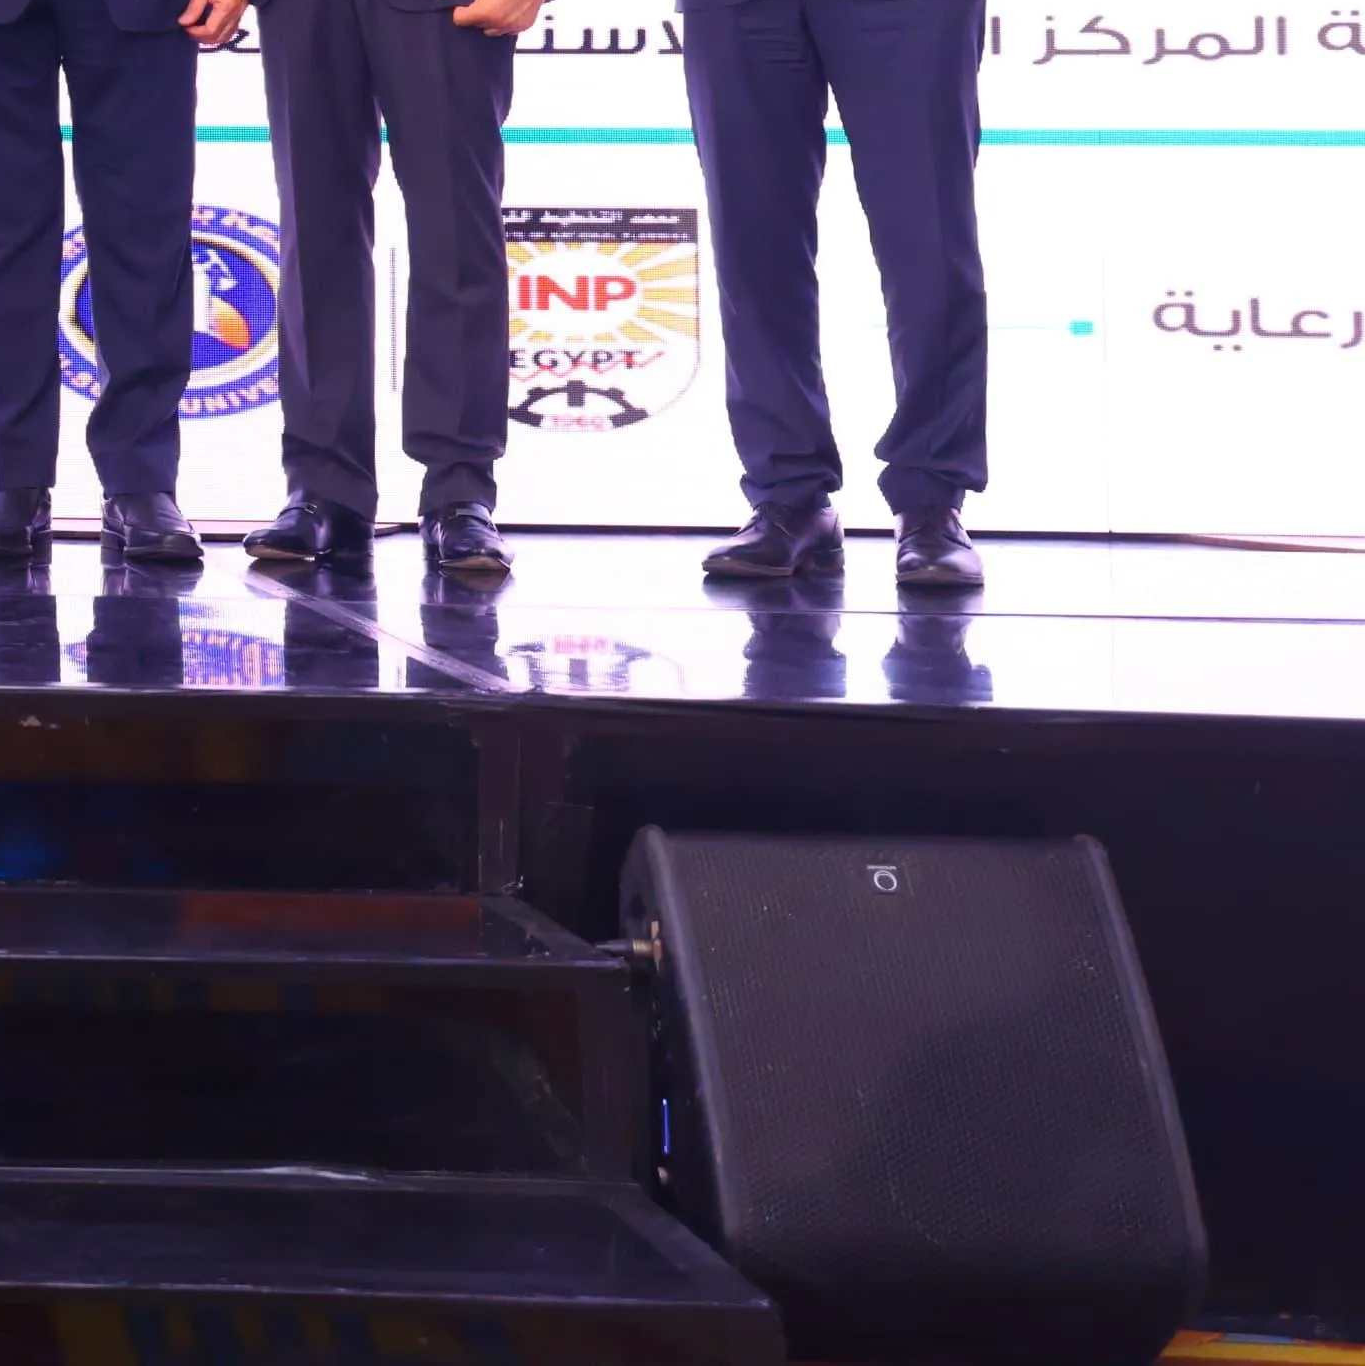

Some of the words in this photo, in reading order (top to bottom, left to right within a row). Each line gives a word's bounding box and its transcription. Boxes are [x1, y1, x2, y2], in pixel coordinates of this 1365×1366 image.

[1032, 15, 1287, 66] المركز
[517, 274, 638, 311] INP
[1152, 289, 1364, 351] رعاية
[509, 349, 642, 370] EGYPT
